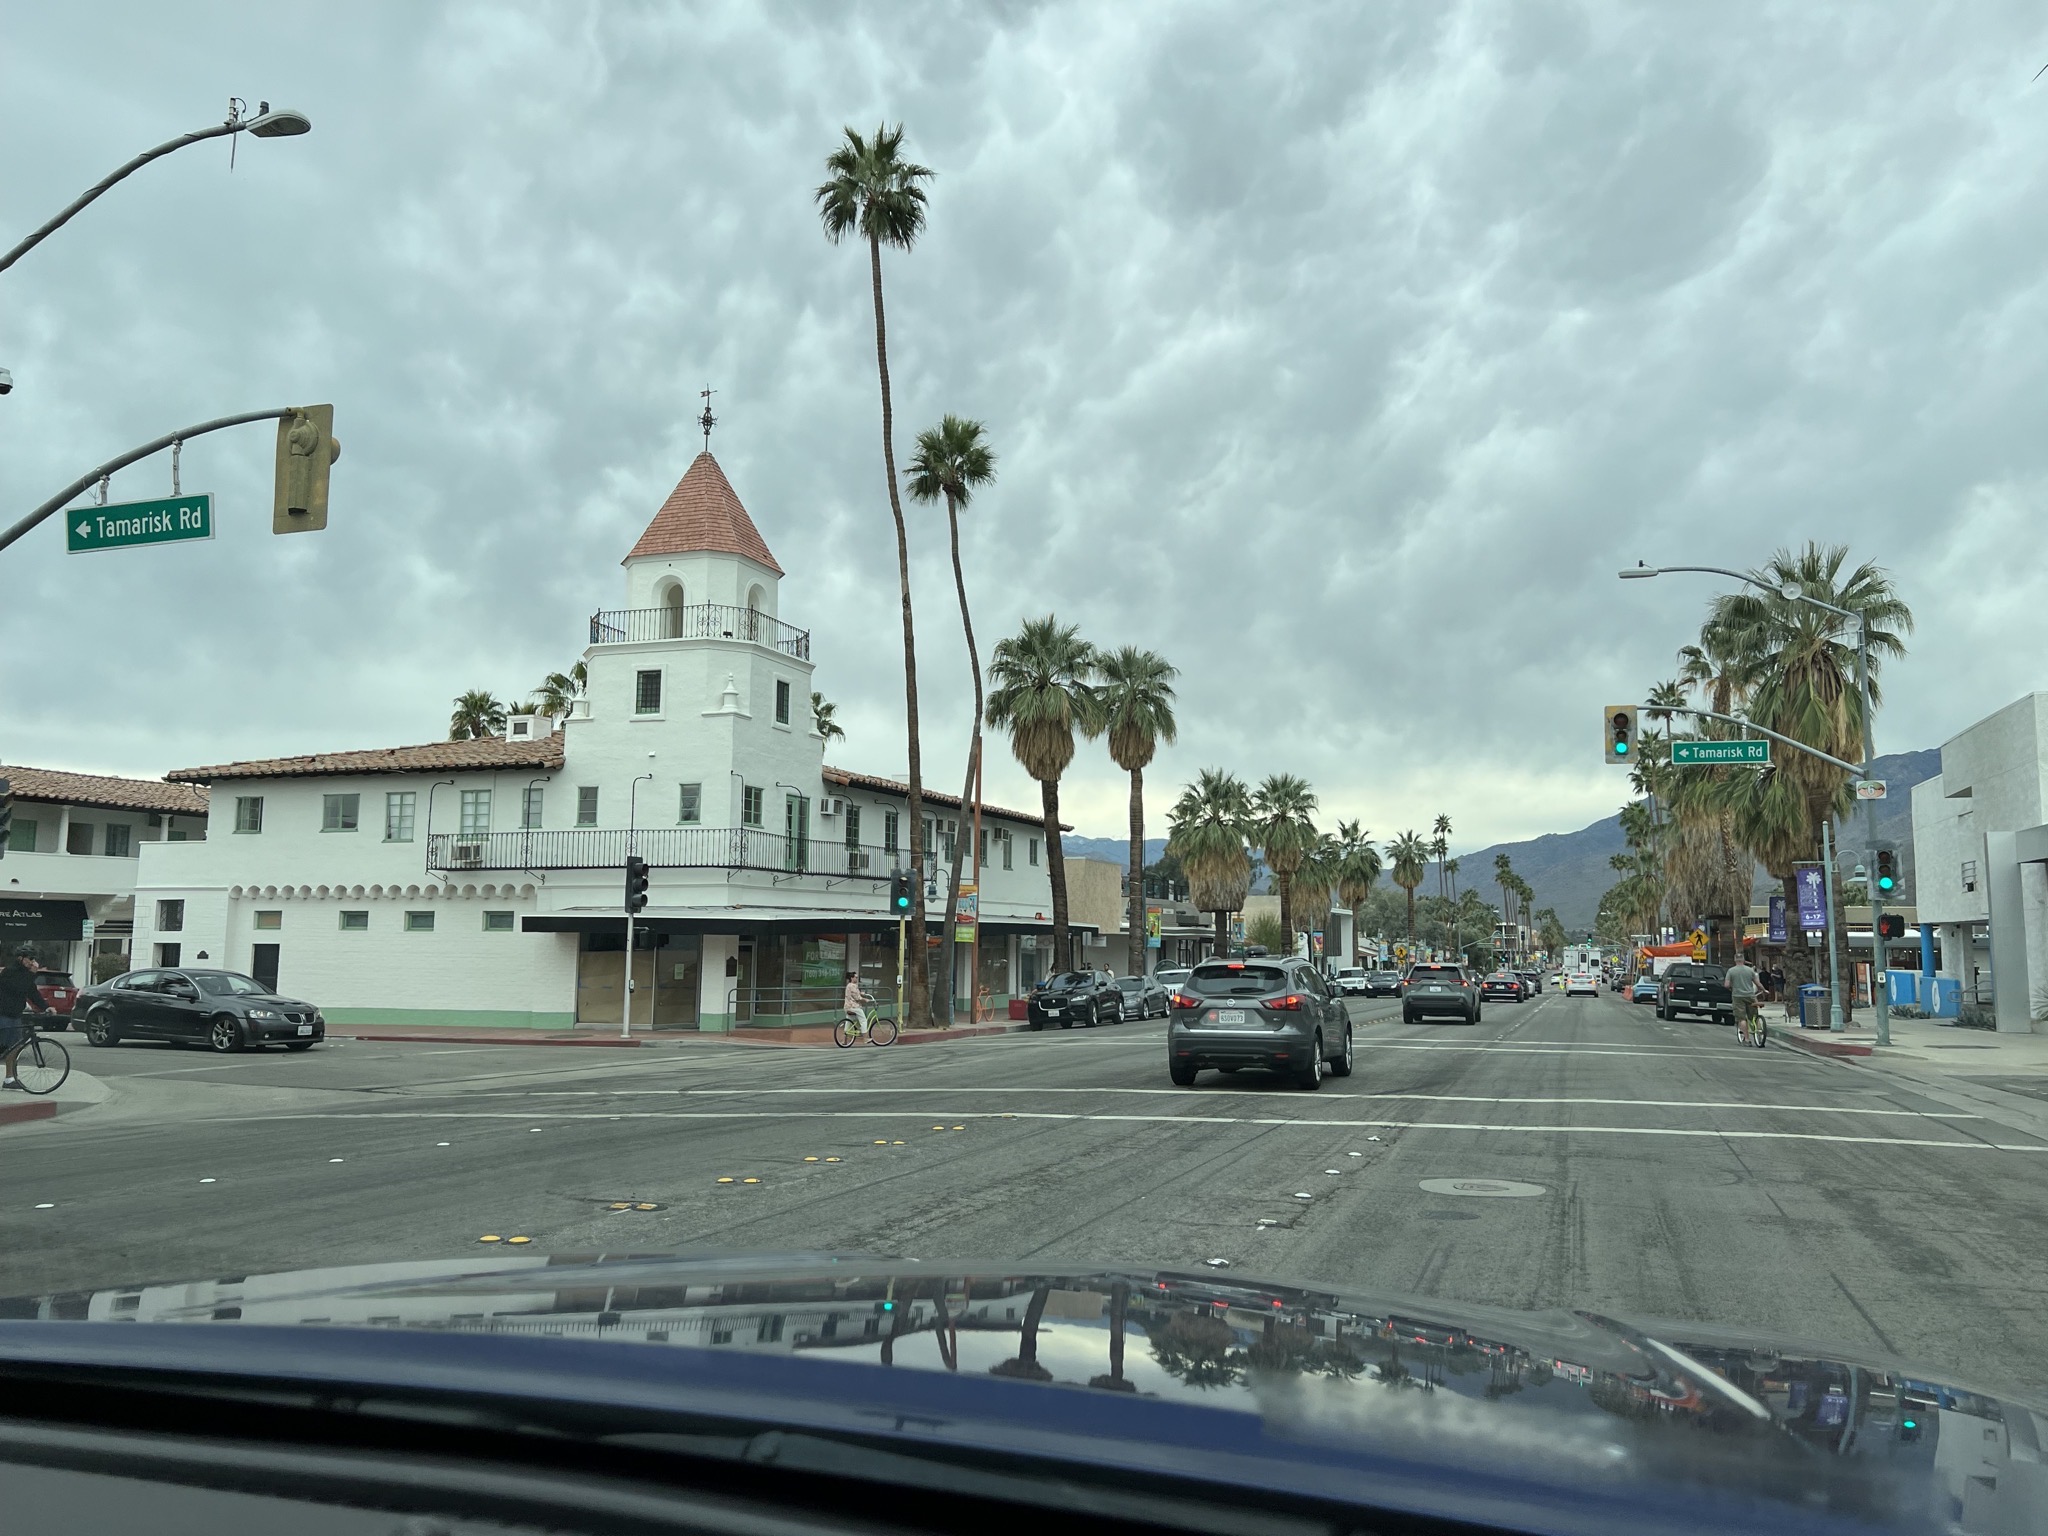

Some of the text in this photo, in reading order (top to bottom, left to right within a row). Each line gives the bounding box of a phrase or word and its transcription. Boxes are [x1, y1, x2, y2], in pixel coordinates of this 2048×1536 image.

[96, 505, 202, 539] Tamarisk Rd
[1692, 746, 1763, 759] Tamarisk Rd
[12, 909, 43, 918] ATLAS
[806, 951, 840, 961] FOR LEASE
